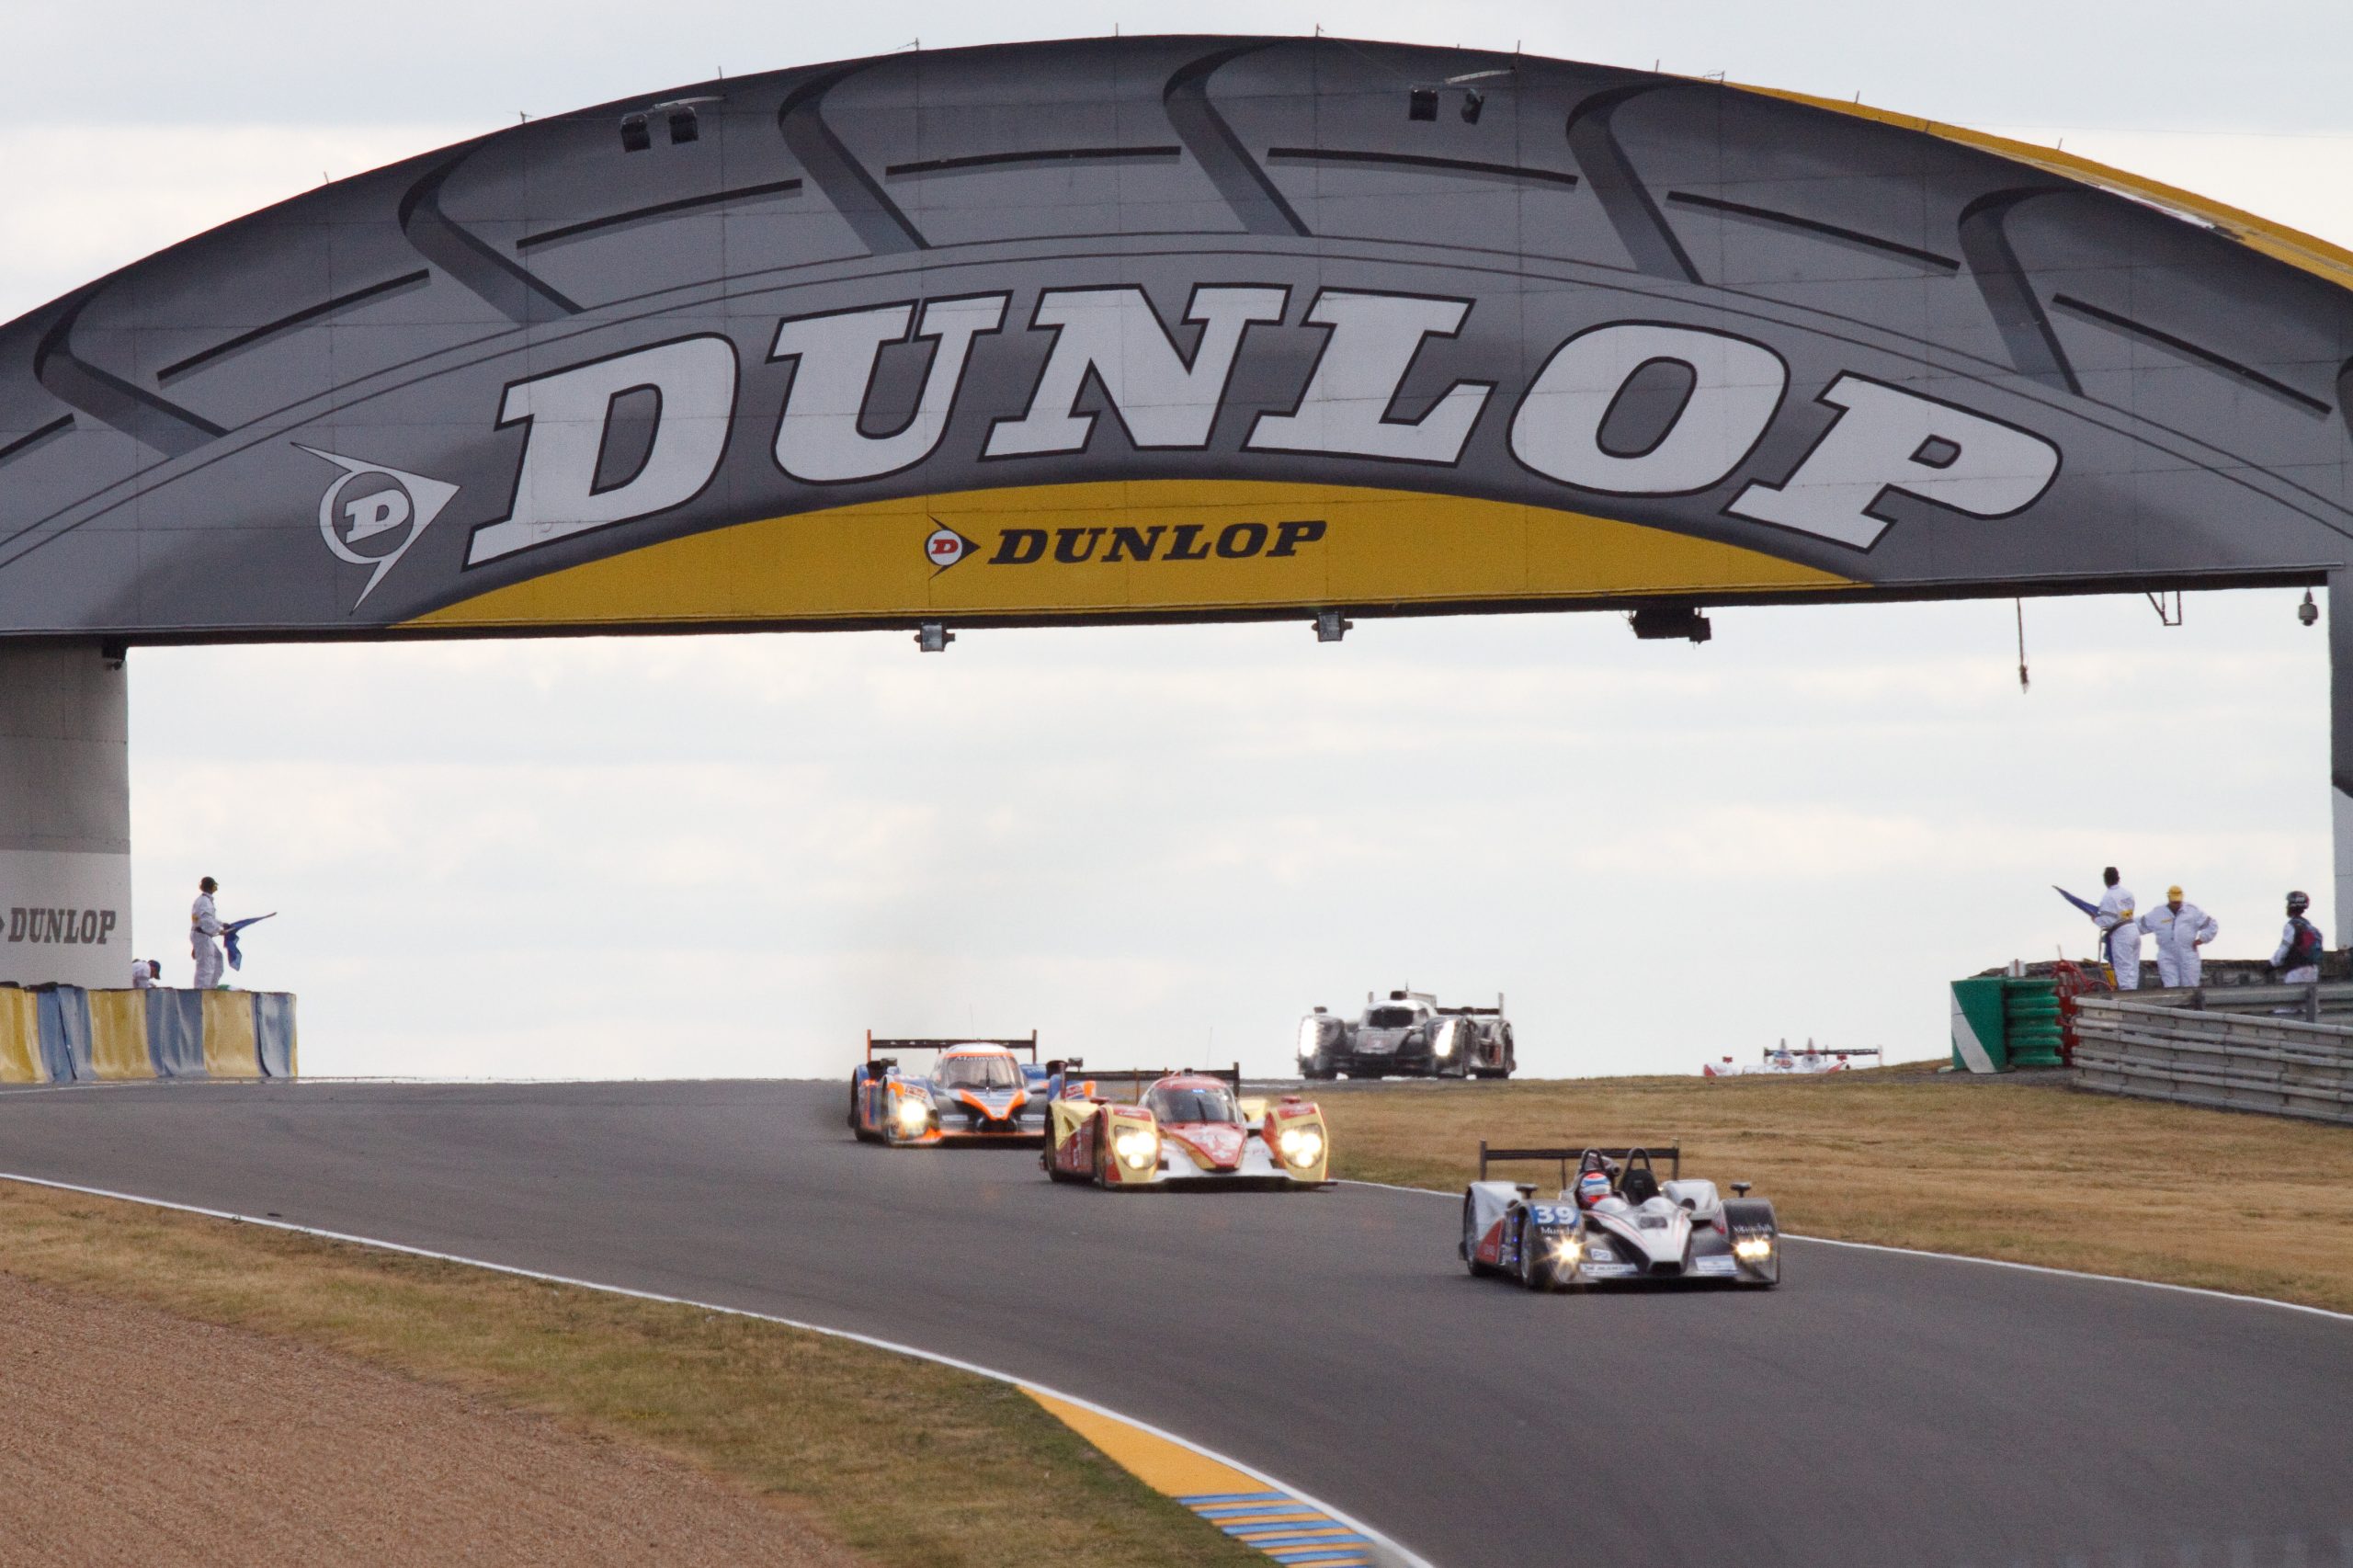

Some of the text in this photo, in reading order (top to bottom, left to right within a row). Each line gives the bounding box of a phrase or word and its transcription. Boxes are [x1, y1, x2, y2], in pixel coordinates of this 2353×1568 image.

[463, 283, 2063, 572] DUNLOP
[344, 488, 410, 544] D
[930, 538, 959, 555] D
[987, 520, 1327, 565] DUNLOP
[7, 906, 117, 945] DUNLOP
[1534, 1205, 1576, 1225] 39
